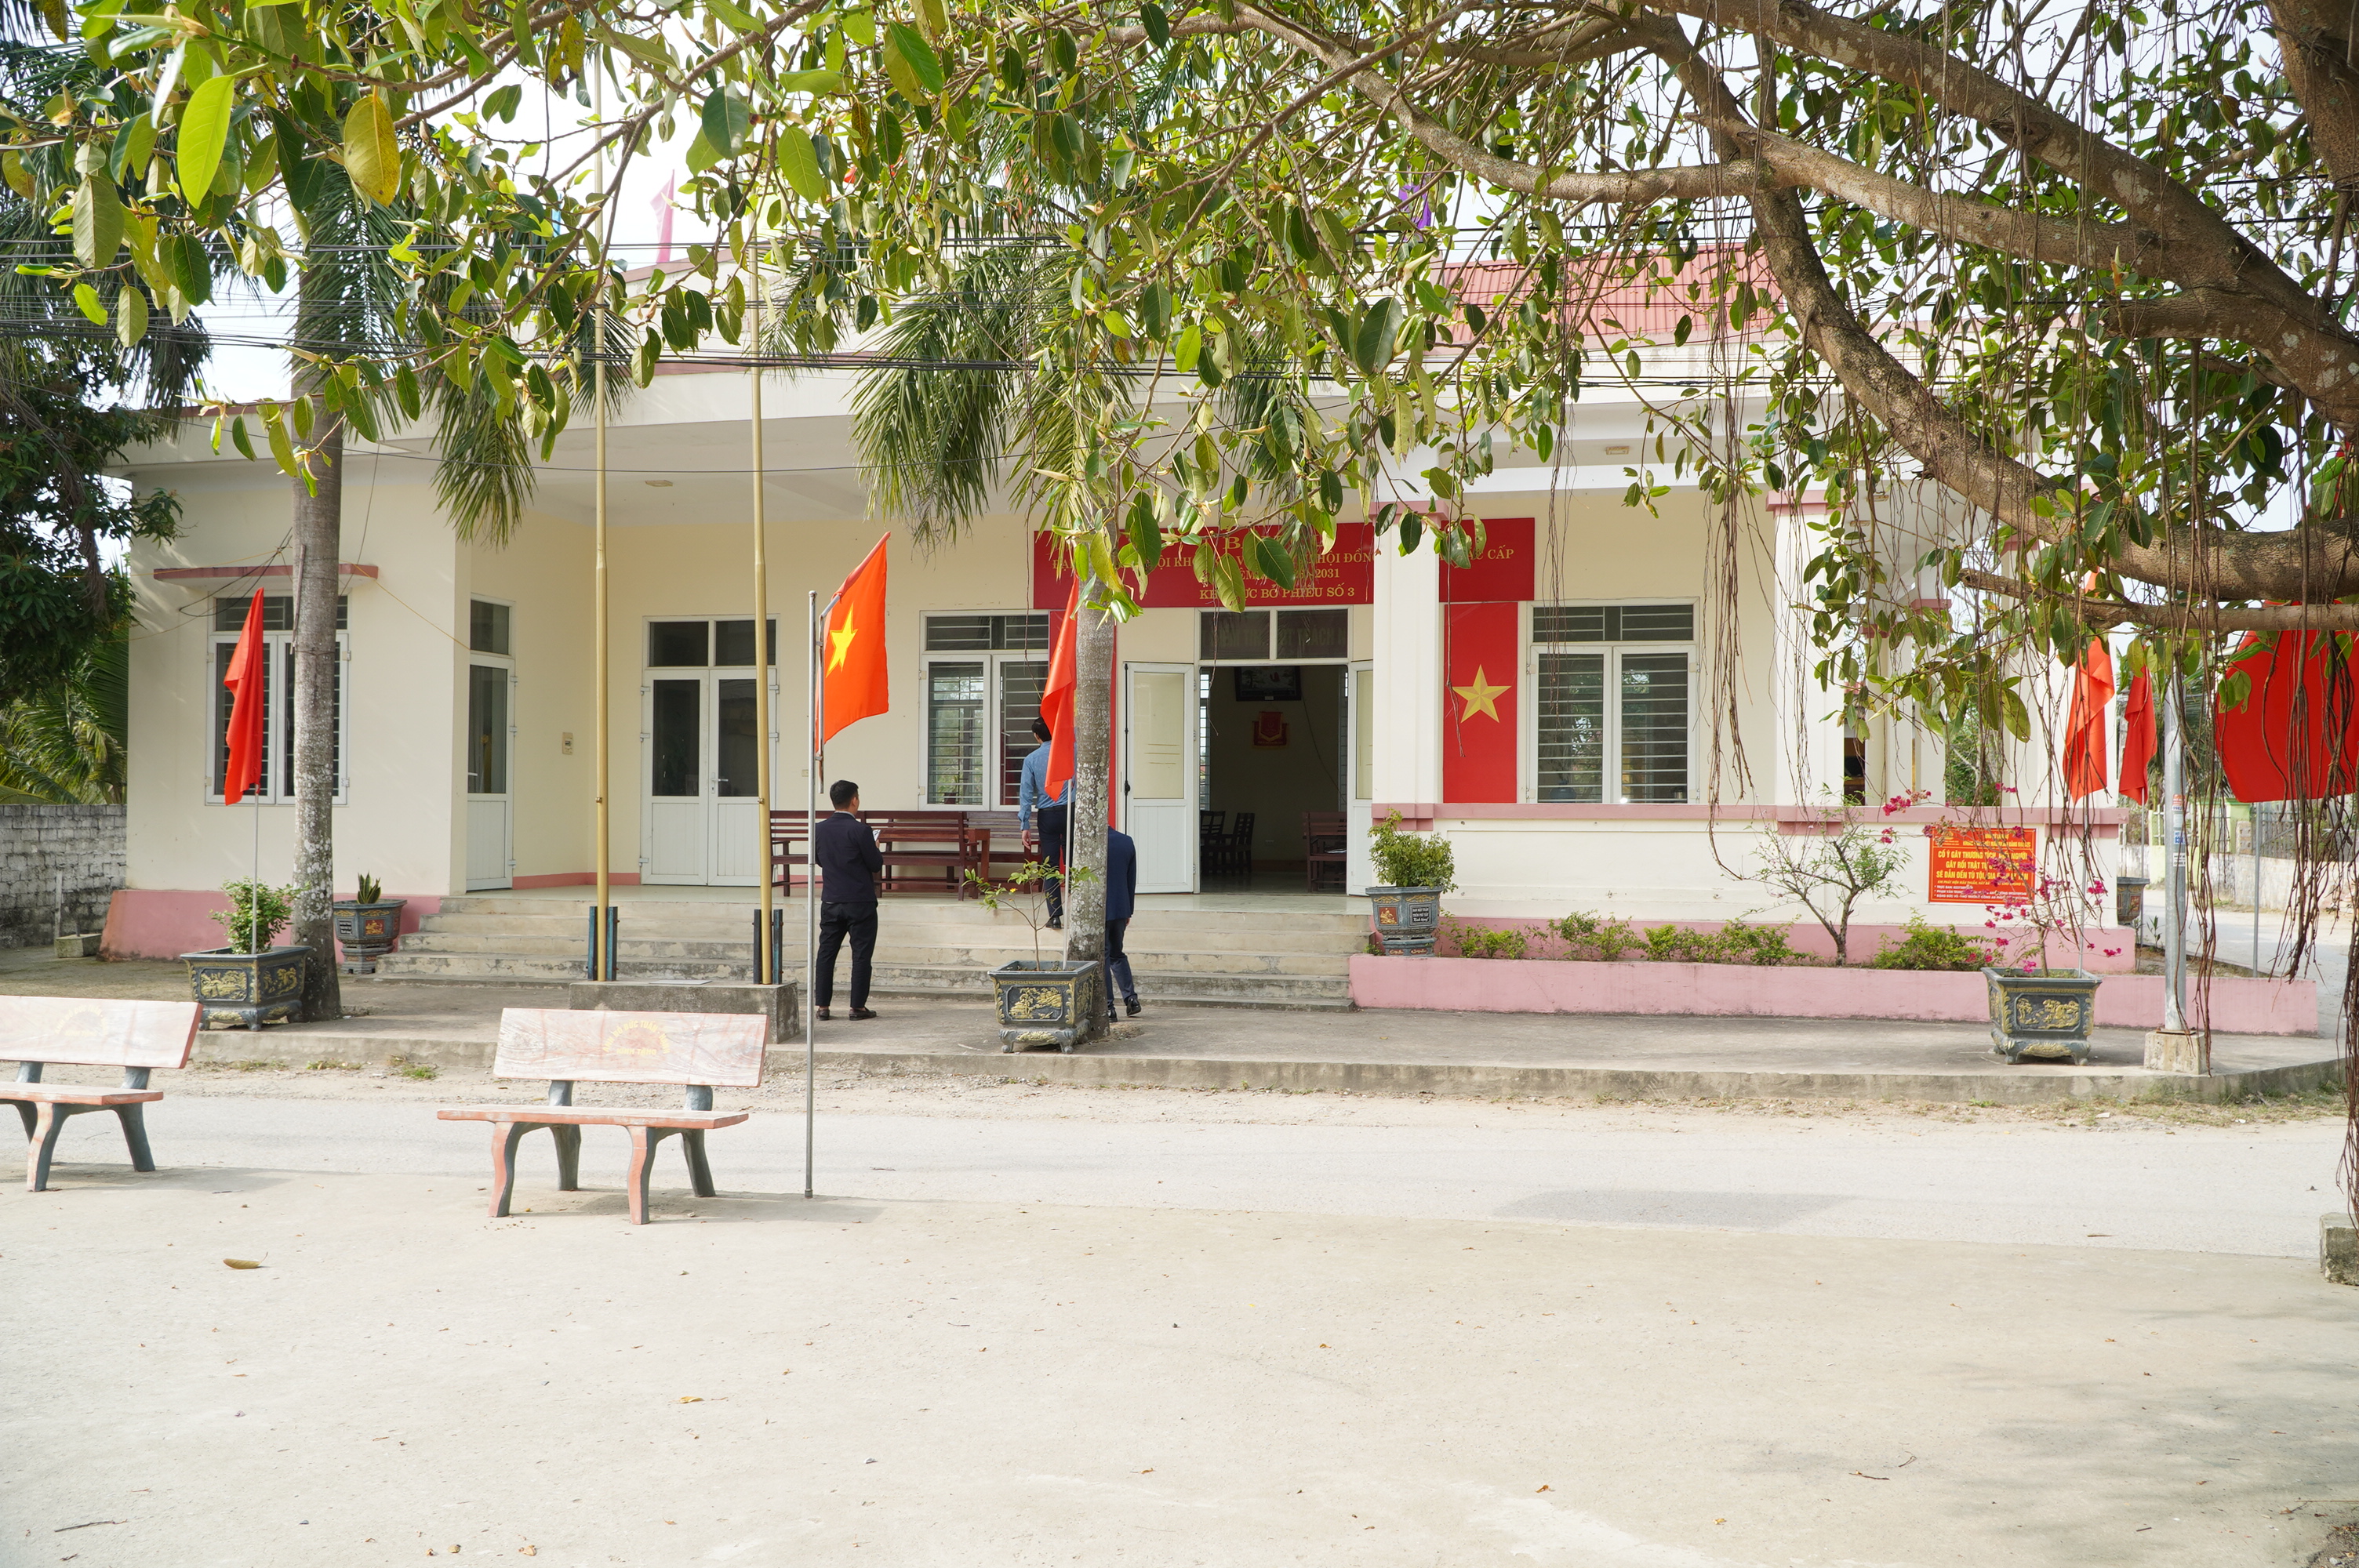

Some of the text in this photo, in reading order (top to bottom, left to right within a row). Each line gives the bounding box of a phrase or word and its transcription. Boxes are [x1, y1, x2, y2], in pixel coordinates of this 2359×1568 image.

[1487, 544, 1514, 560] CẤP
[1315, 568, 1339, 579] 2031
[1327, 583, 1345, 597] SỐ
[1347, 587, 1355, 597] 3
[1938, 849, 1946, 858] CỐ
[1946, 849, 1950, 858] Ý
[1950, 850, 1961, 858] GÂY
[1946, 859, 1957, 869] GÂY
[1968, 860, 1980, 870] TRẬT
